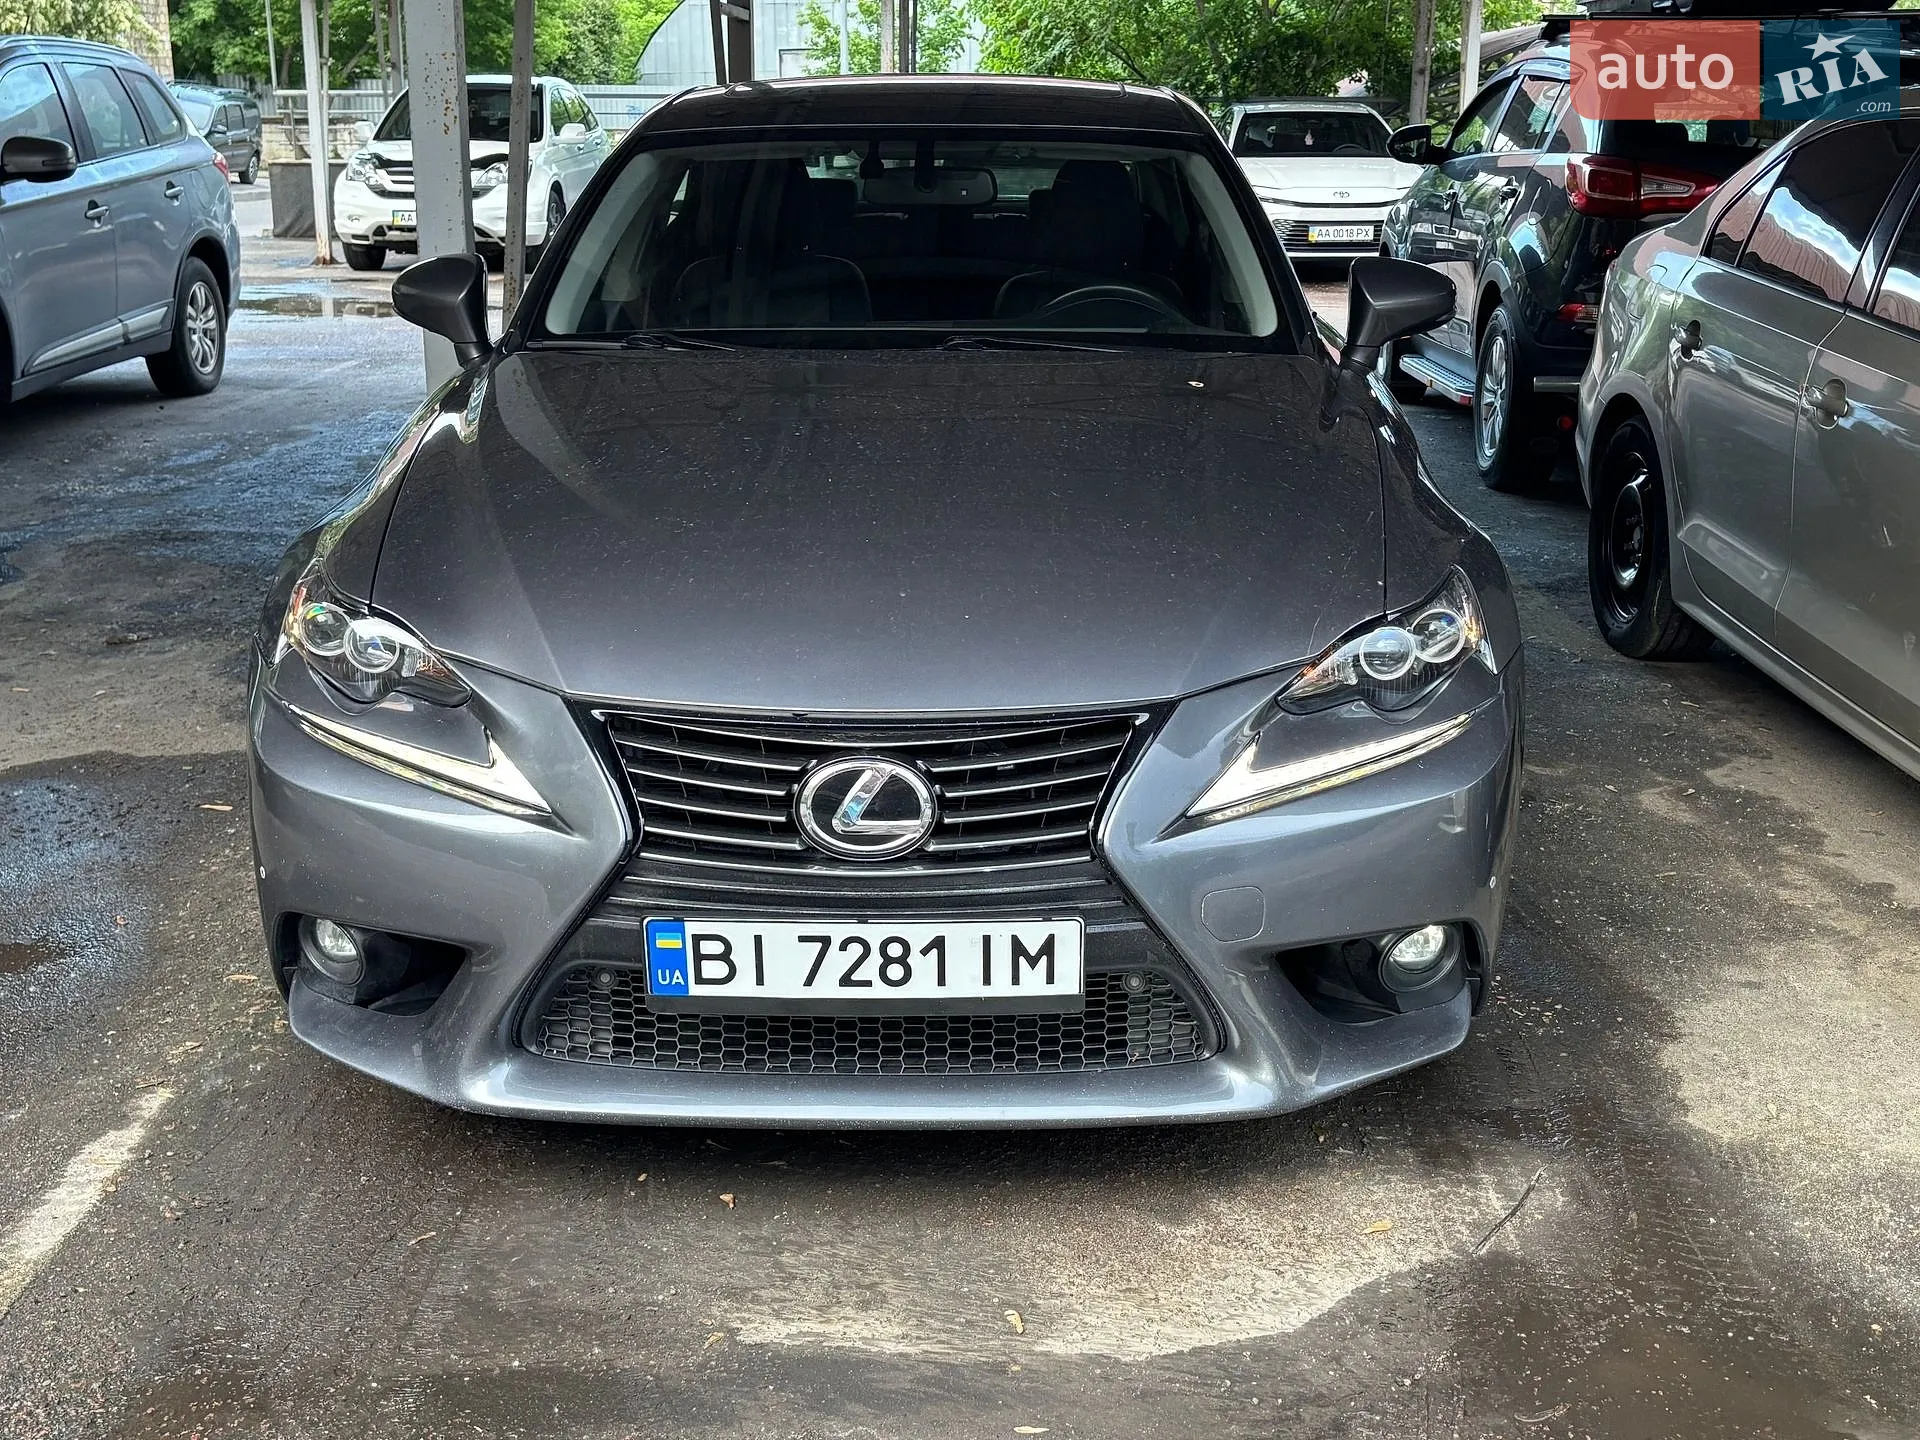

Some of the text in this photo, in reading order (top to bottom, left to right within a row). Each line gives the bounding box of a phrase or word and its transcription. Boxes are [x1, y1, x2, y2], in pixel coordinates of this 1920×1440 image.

[400, 213, 414, 222] AA
[1317, 229, 1370, 238] AA 0018 PX
[691, 933, 1055, 988] BI 7281 IM
[657, 968, 685, 985] UA
